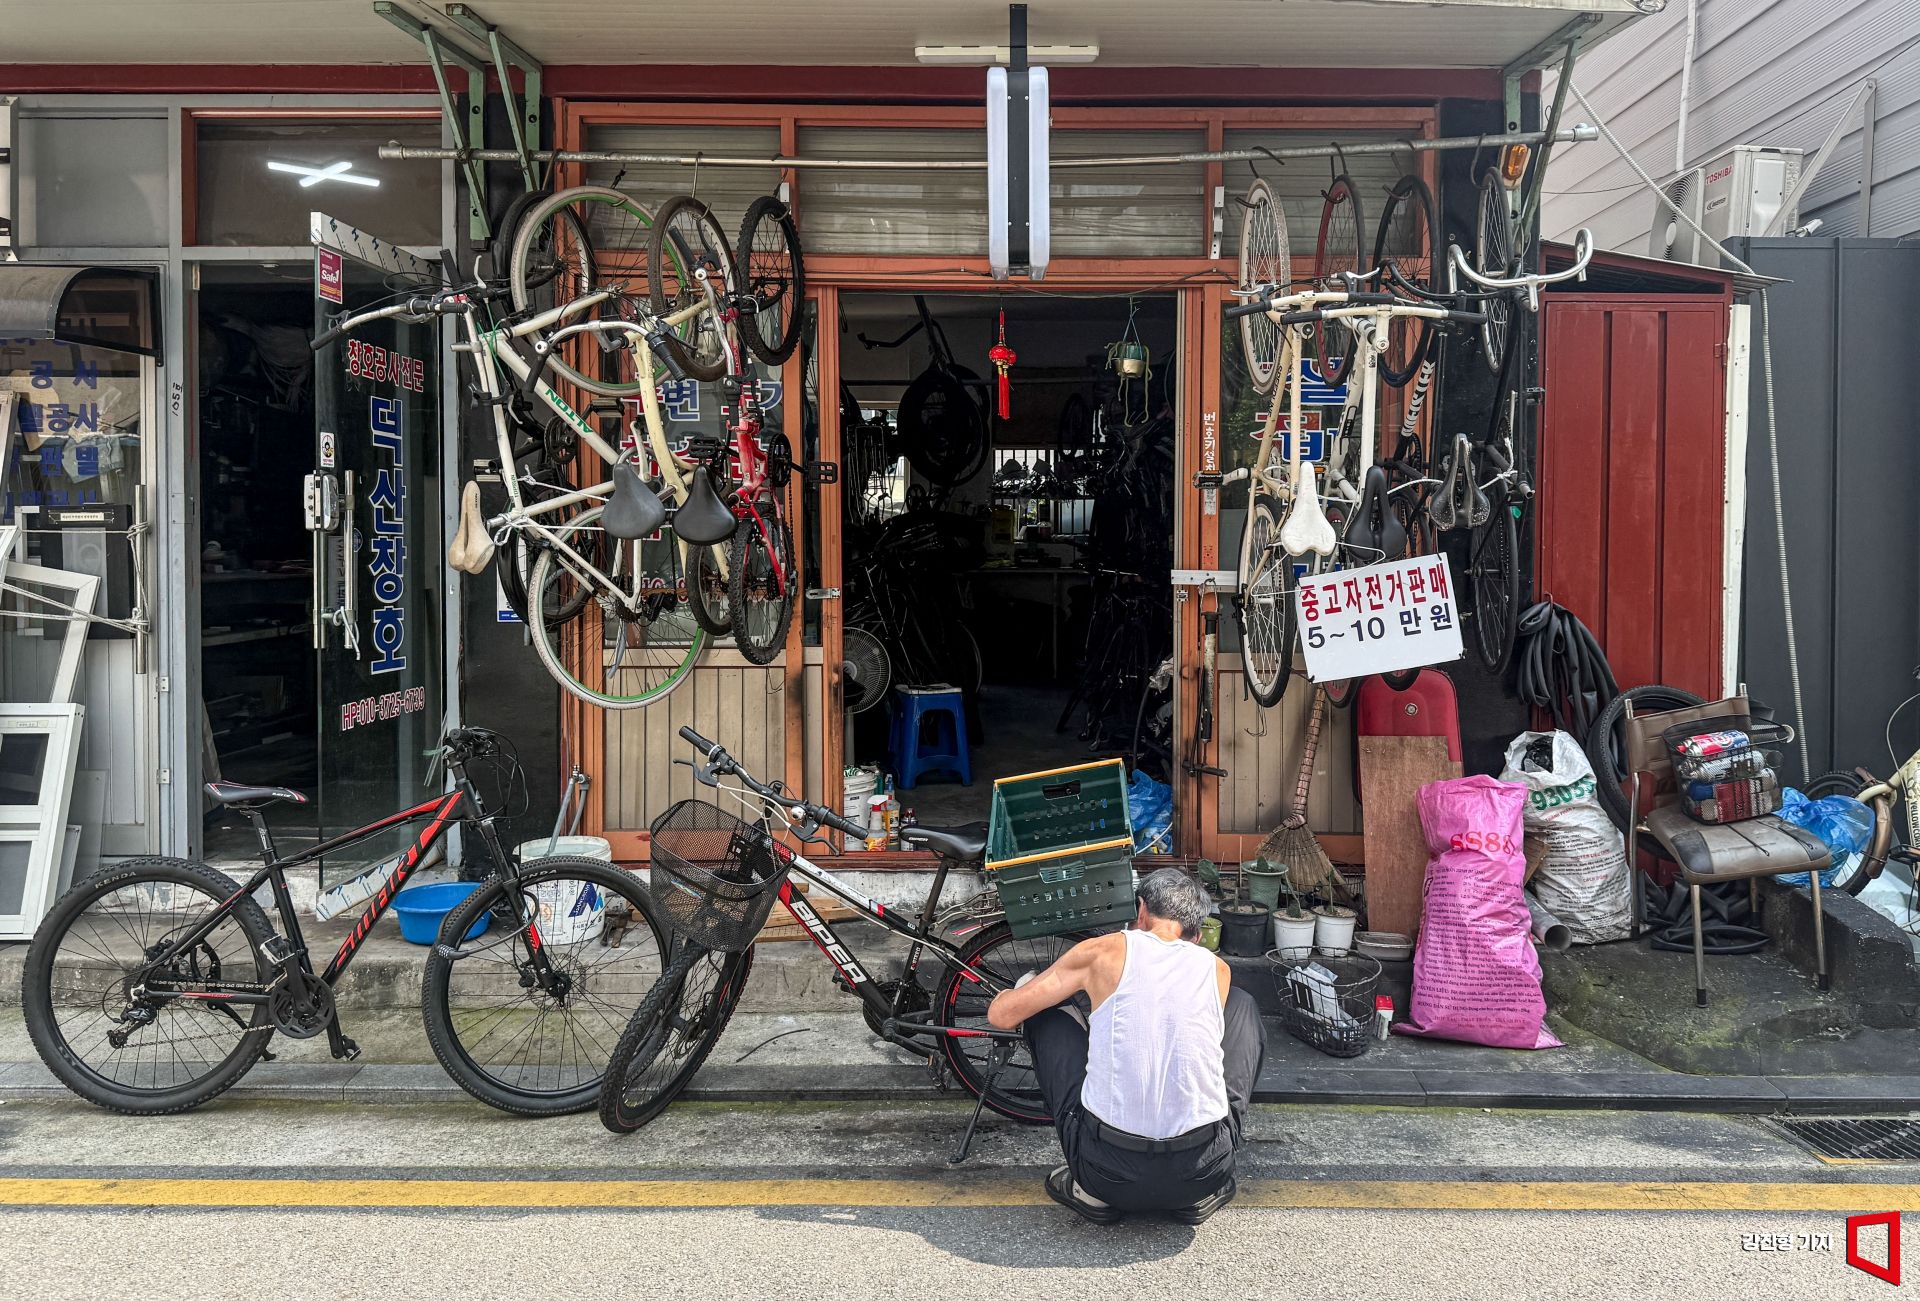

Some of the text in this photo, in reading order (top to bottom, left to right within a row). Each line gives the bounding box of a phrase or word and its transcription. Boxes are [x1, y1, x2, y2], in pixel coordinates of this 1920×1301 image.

[1705, 164, 1734, 185] TOSHIBA
[544, 388, 594, 435] ALTON
[368, 395, 408, 676] 덕산창호
[1300, 562, 1450, 622] 중고자전거판매
[1307, 602, 1453, 650] 5~10 만 원
[94, 871, 138, 889] KENDA
[789, 899, 869, 985] BIPER
